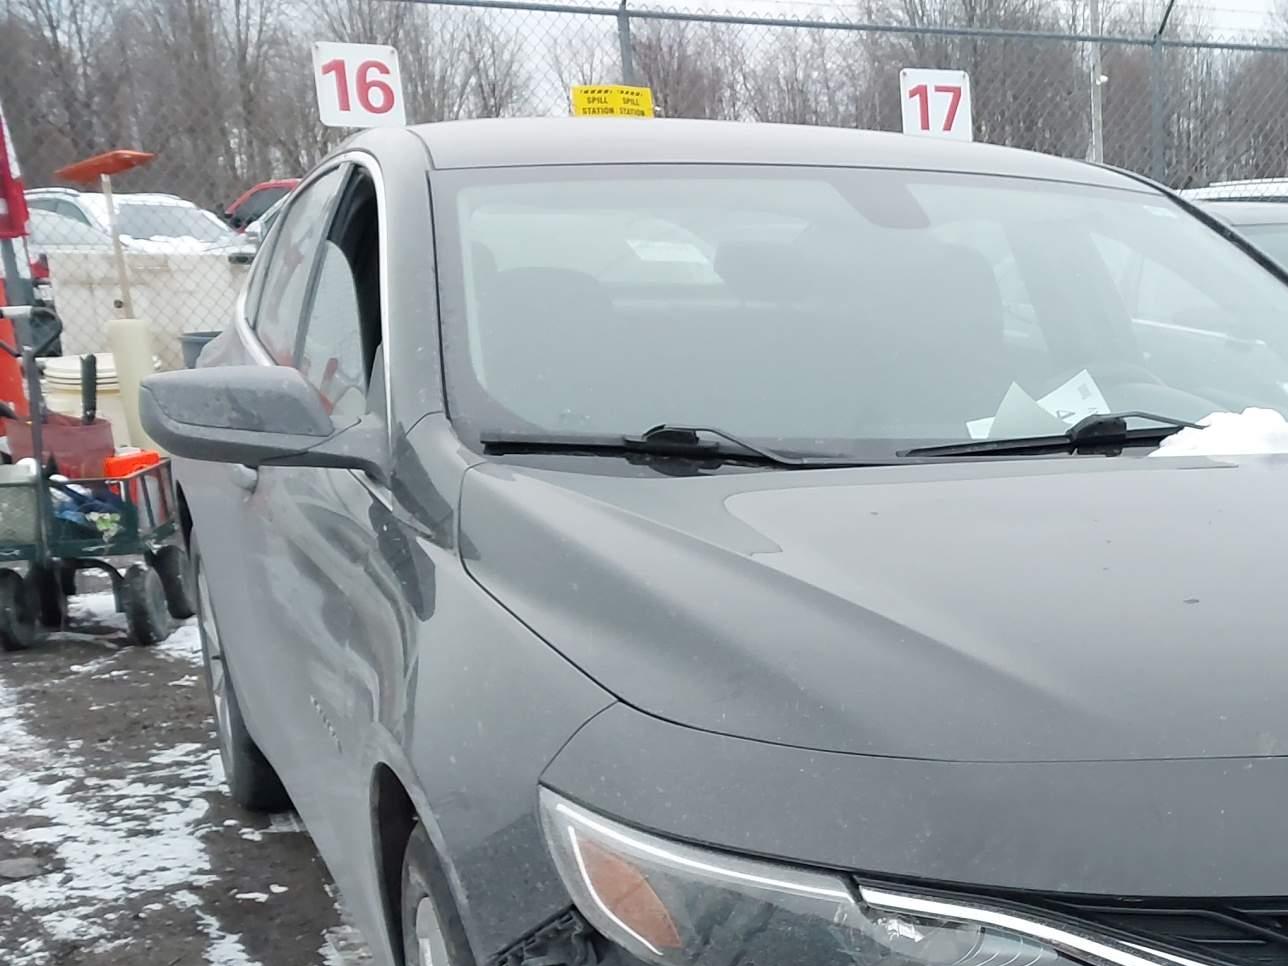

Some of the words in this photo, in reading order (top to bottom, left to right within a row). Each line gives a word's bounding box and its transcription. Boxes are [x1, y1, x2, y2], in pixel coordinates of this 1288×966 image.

[321, 59, 395, 114] 16
[586, 96, 608, 105] SPILL
[622, 97, 640, 106] SPILL
[581, 107, 615, 115] STATION
[619, 107, 646, 117] STATION
[908, 84, 962, 132] 17
